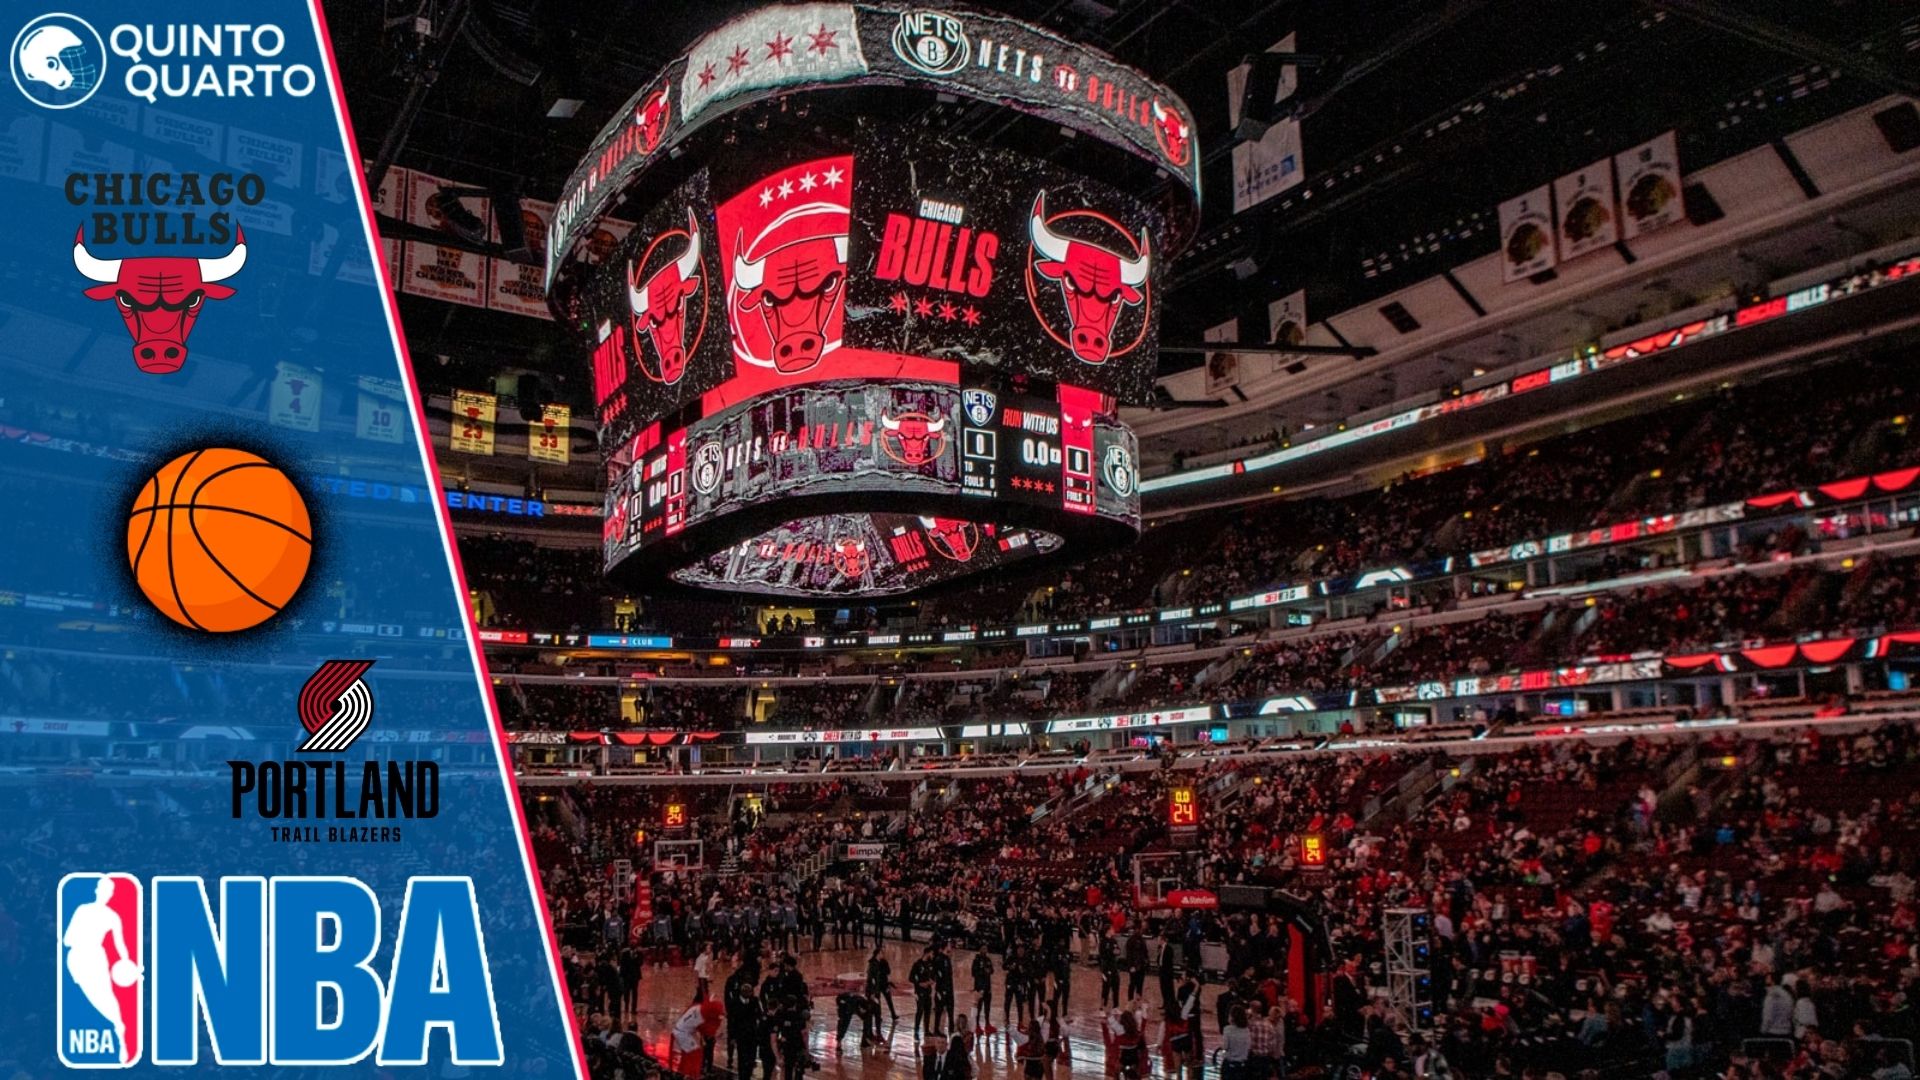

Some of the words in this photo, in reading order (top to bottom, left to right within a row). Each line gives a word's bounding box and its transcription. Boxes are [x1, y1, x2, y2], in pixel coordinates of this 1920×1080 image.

[904, 13, 961, 42] NETS
[978, 39, 1043, 83] NETS
[1057, 69, 1075, 91] VS
[1087, 74, 1149, 127] BULLS
[919, 199, 964, 225] CHICAGO
[874, 212, 999, 298] BULLS
[500, 286, 546, 301] CHAMPIO
[964, 391, 994, 408] NETS
[372, 410, 391, 427] 10
[1003, 408, 1022, 428] RUN
[1023, 412, 1045, 432] WITH
[1046, 416, 1059, 435] US
[463, 423, 484, 440] 23
[540, 433, 558, 448] 33
[727, 436, 762, 471] NETS
[798, 421, 874, 450] BULLS
[976, 434, 985, 455] 0
[1023, 438, 1049, 466] 0.0
[964, 475, 984, 488] FOULS
[448, 491, 544, 517] ENTER
[632, 637, 653, 646] CLUB
[667, 813, 683, 824] 24
[1173, 804, 1194, 823] 24
[1306, 849, 1321, 862] 24
